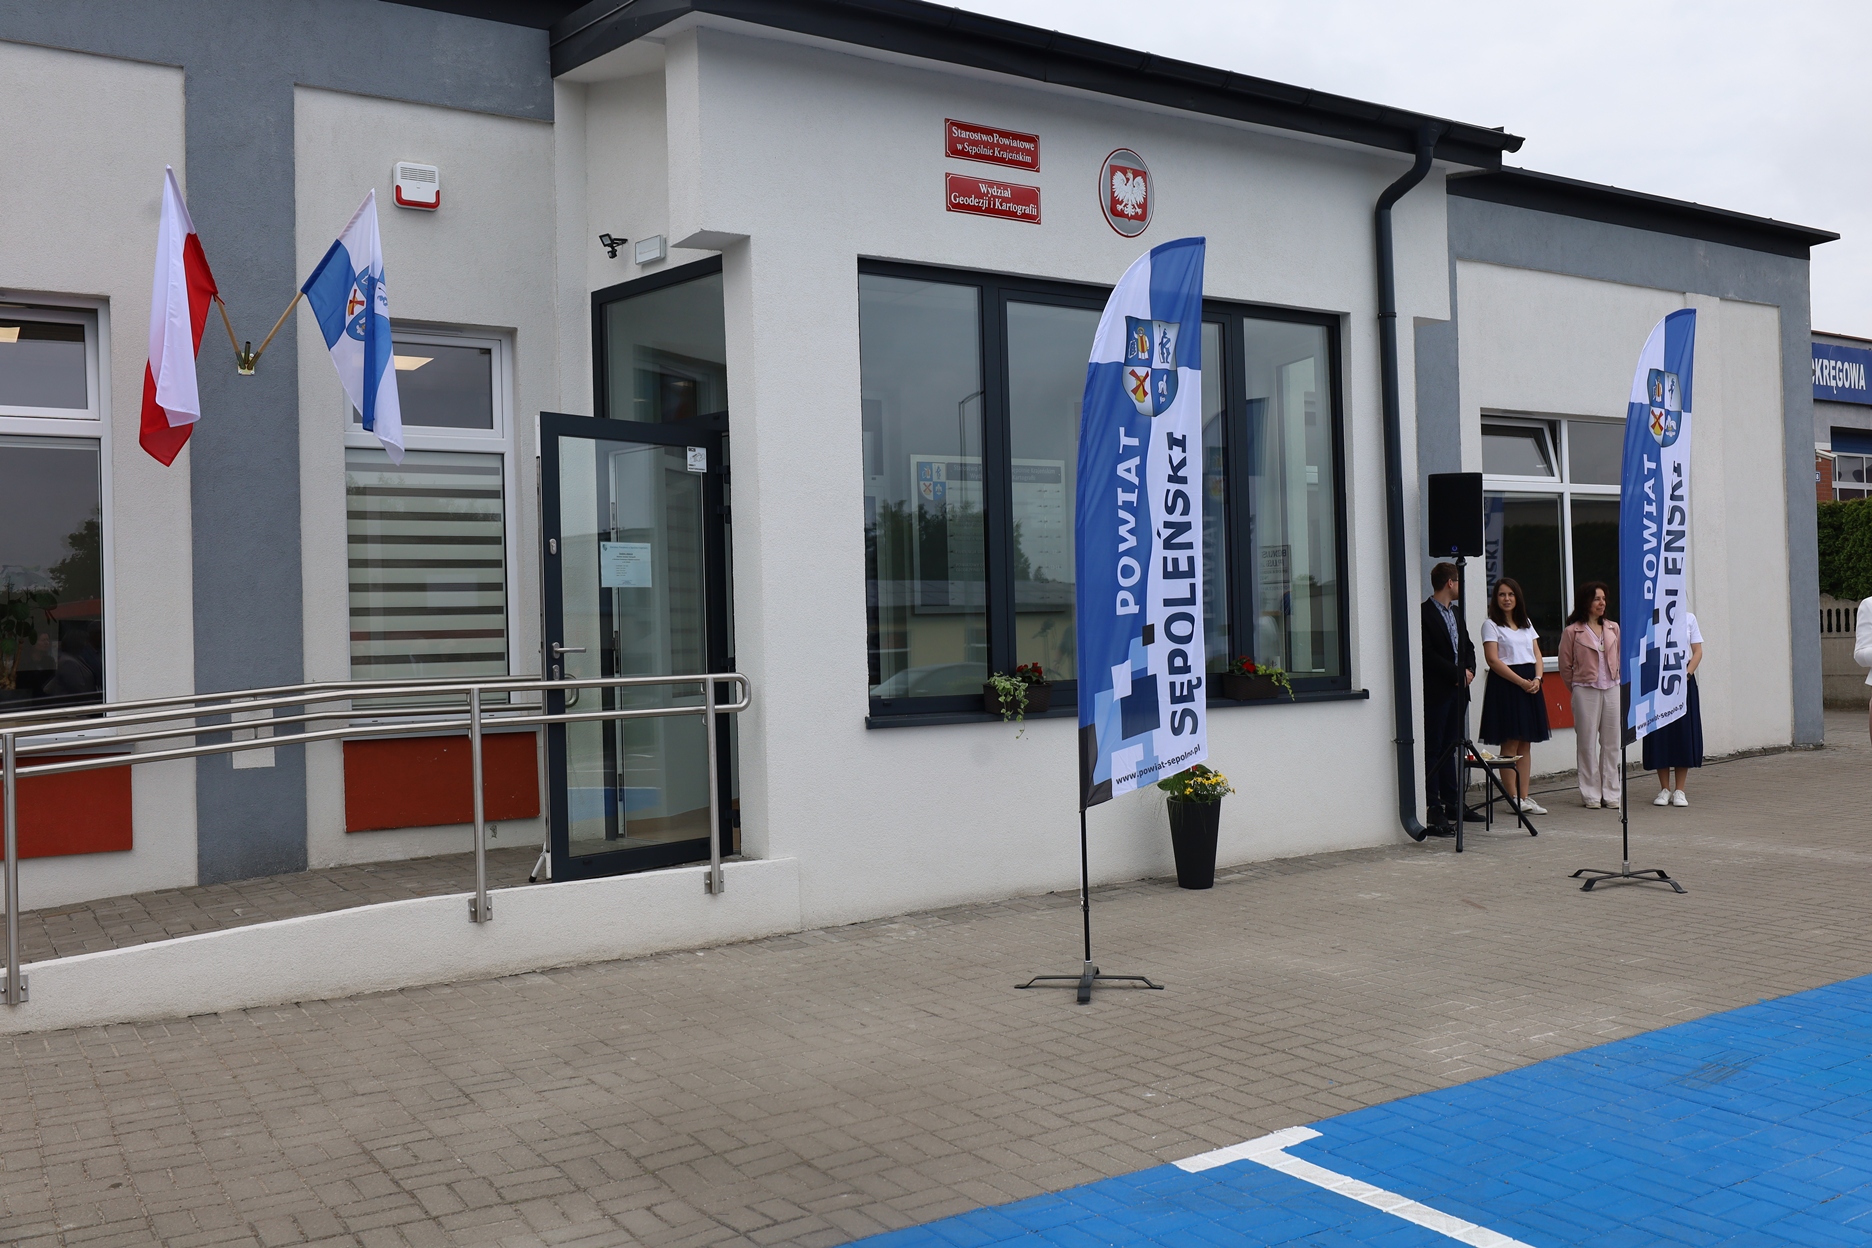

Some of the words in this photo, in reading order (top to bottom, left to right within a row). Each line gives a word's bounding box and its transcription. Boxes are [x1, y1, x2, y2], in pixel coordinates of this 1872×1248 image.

[952, 126, 993, 142] Starostwo
[993, 133, 1035, 151] Powiatowe
[956, 143, 964, 151] w
[964, 142, 993, 156] Sępólnie
[994, 147, 1032, 163] Krajeńskim
[951, 192, 989, 209] Geodezji
[990, 198, 995, 208] i
[995, 198, 1037, 215] Kartografii
[978, 183, 1011, 198] Wydział
[1115, 426, 1141, 616] POWIAT
[1643, 454, 1658, 600] POWIAT
[1156, 431, 1203, 737] SĘPOLEŃSKI
[1115, 743, 1202, 785] www.powiat-sepolno.pl
